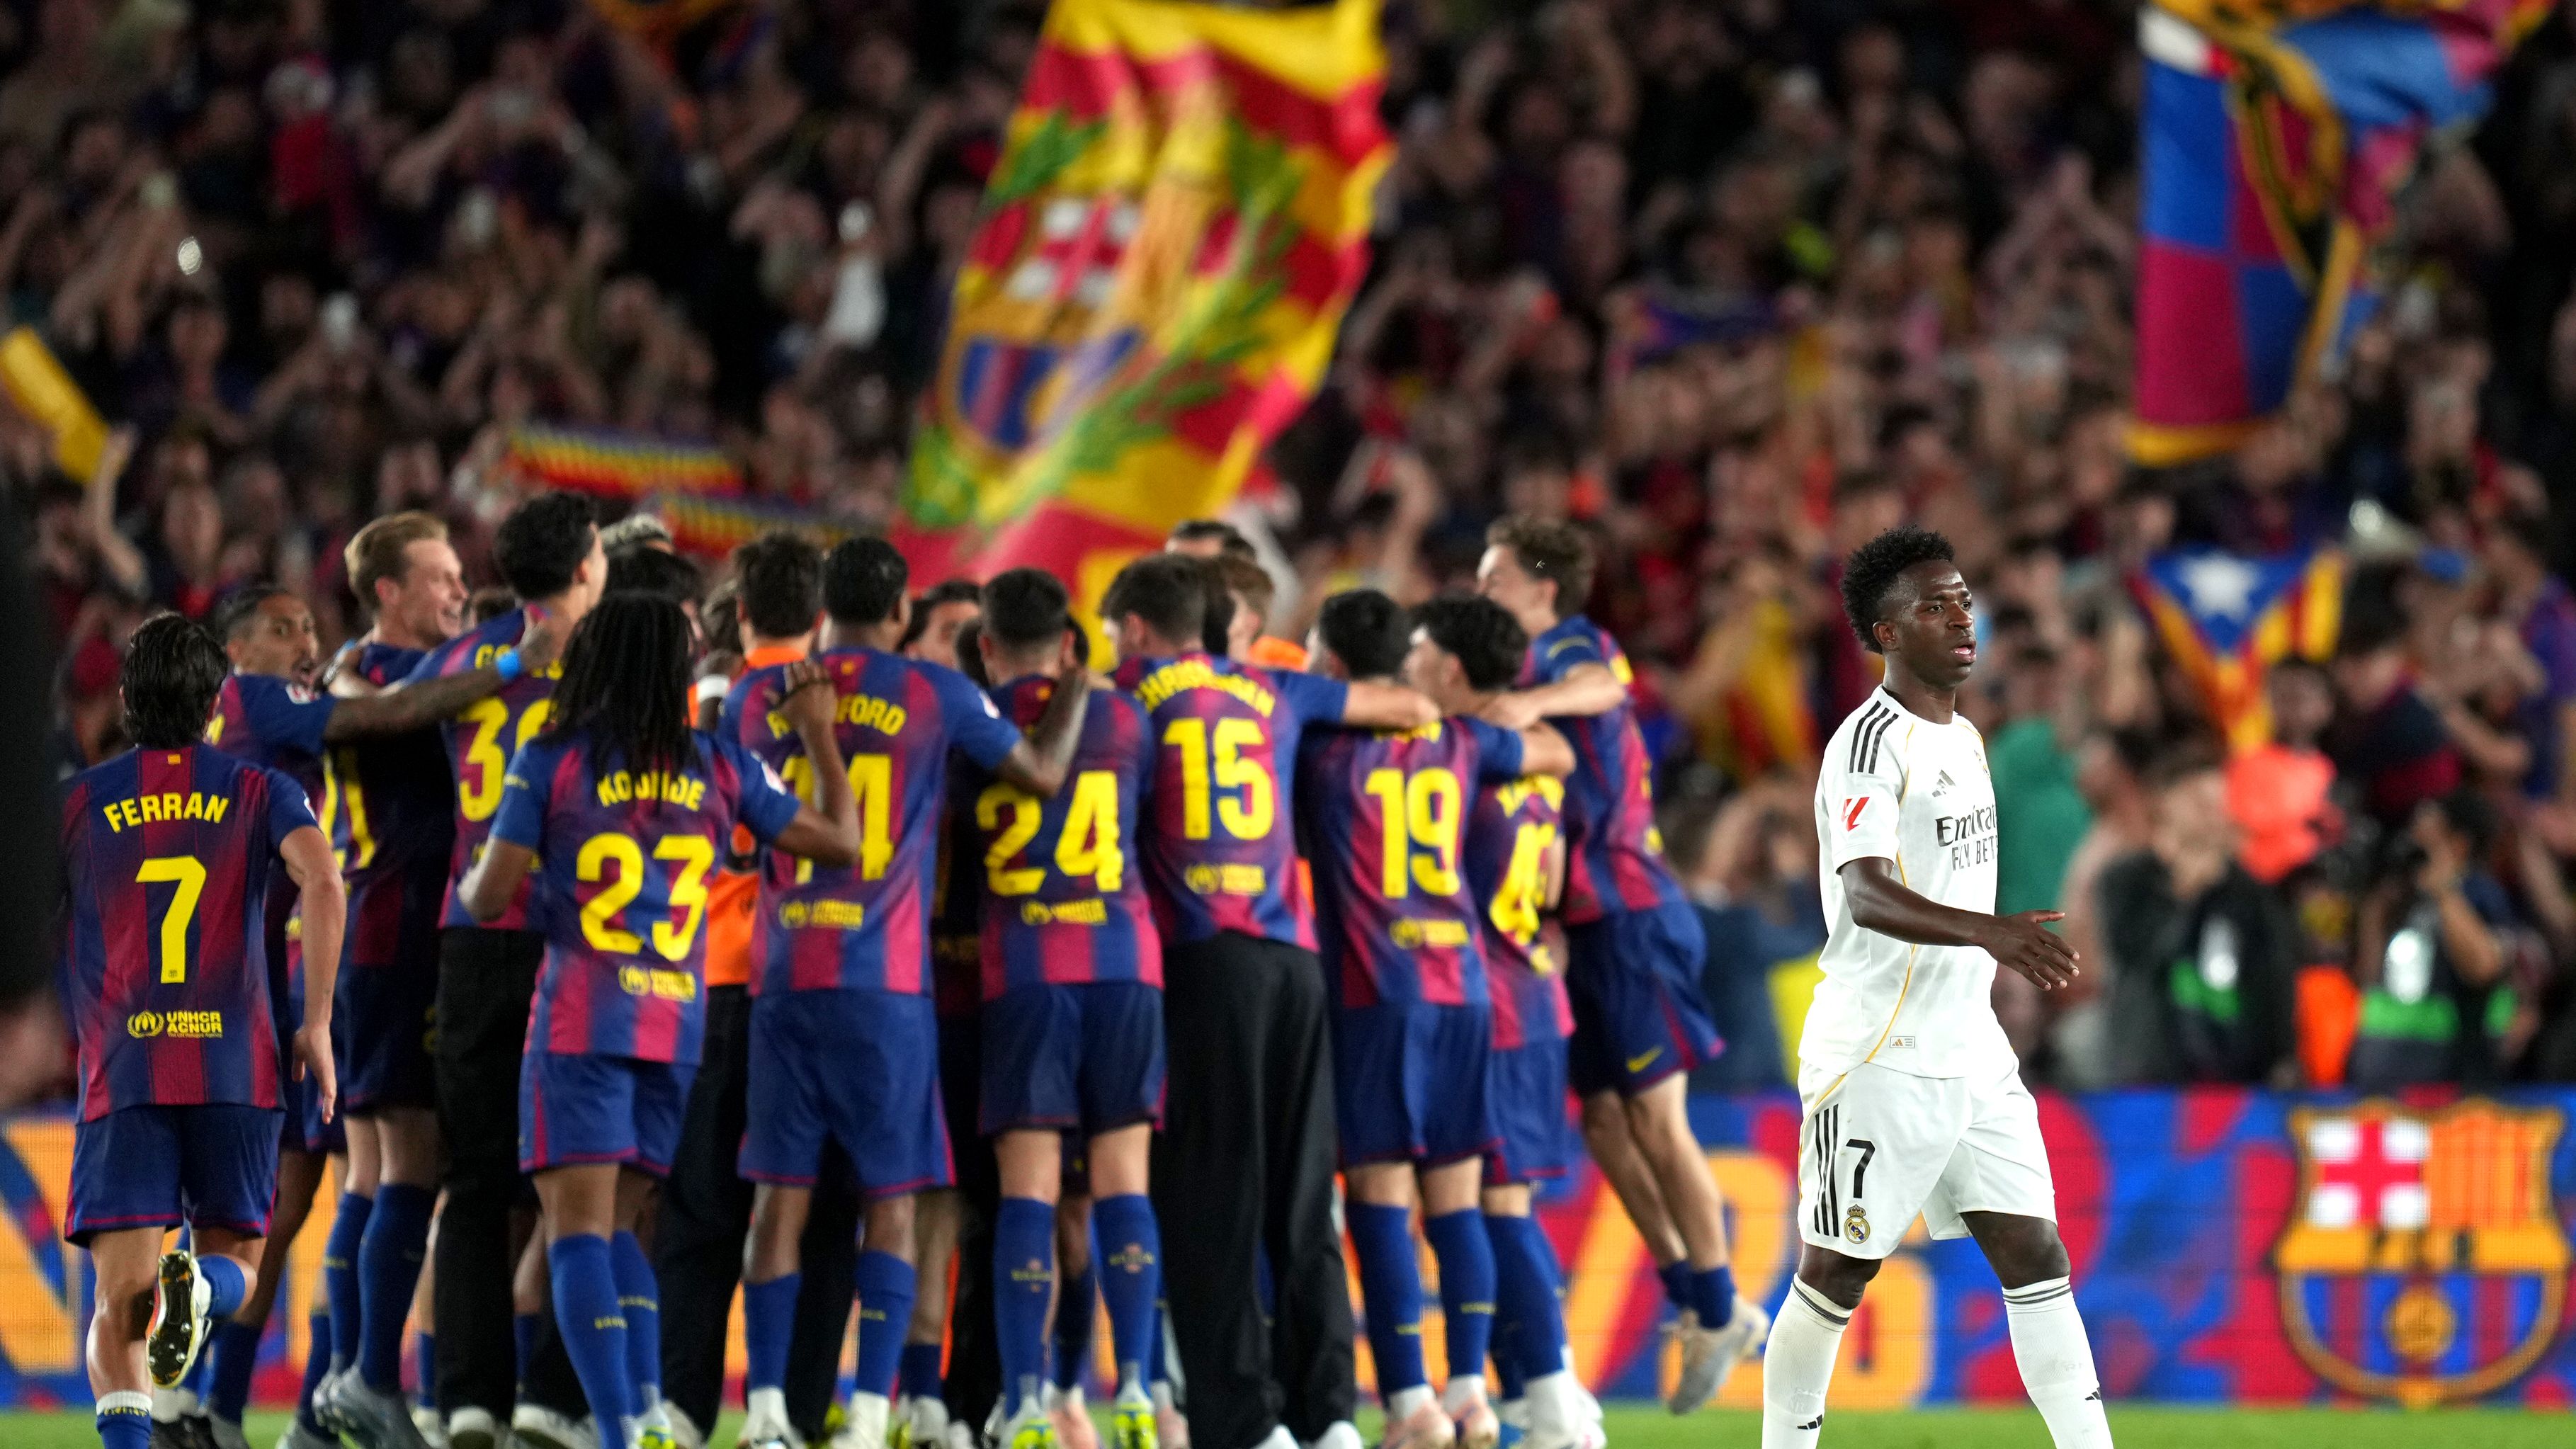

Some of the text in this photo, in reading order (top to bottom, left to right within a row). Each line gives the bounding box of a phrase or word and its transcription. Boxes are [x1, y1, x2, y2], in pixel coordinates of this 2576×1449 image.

[103, 791, 229, 834] FERRAN
[1163, 716, 1274, 841] 15
[975, 770, 1124, 897] 24
[1365, 766, 1461, 899] 19
[1951, 843, 1970, 871] FLY
[135, 854, 207, 984] 7
[576, 831, 715, 962] 23
[166, 1010, 222, 1023] UNHCR
[166, 1022, 222, 1033] ACNUR
[1846, 1138, 1876, 1199] 7
